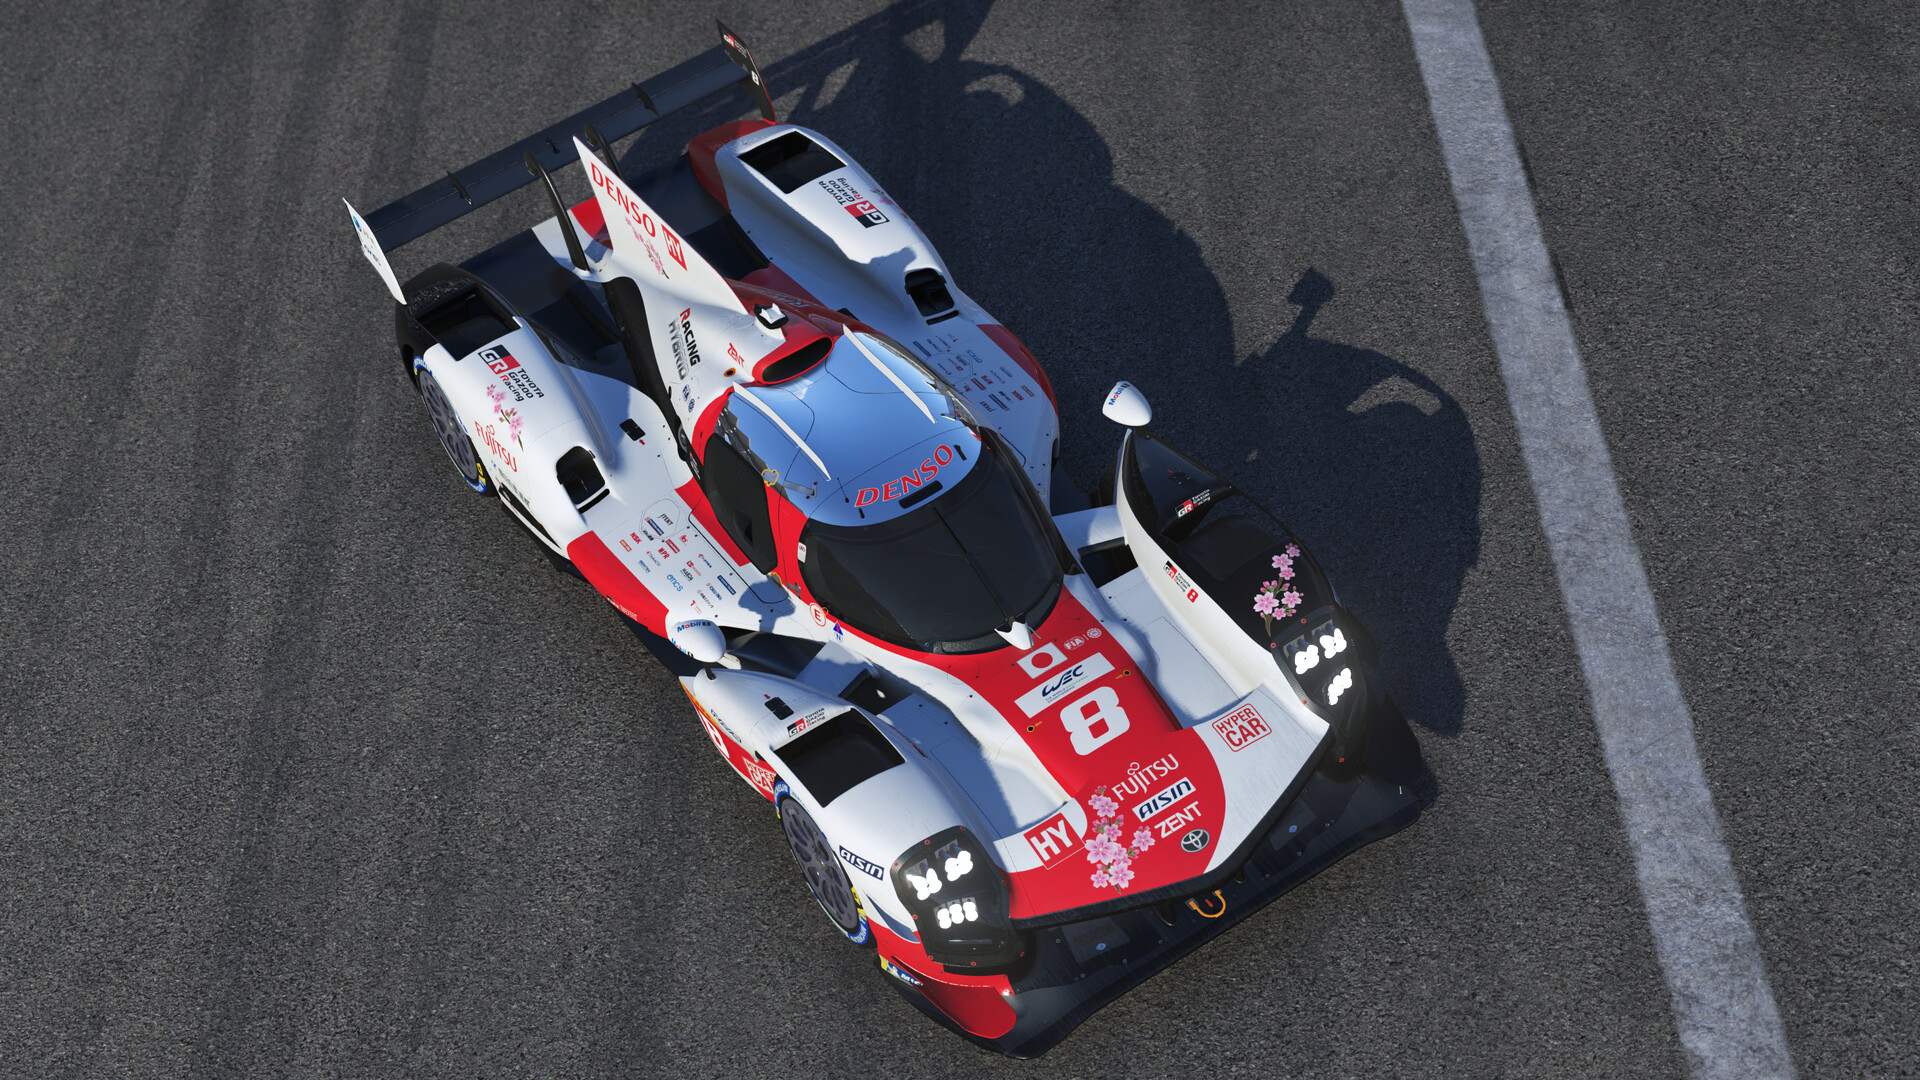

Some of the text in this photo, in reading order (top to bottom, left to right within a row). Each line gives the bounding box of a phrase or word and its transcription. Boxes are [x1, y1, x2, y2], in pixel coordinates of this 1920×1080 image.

[590, 162, 656, 238] DENSO
[818, 180, 847, 206] TOYOTA
[828, 179, 856, 203] GAZOO
[837, 177, 864, 200] Racing
[855, 201, 889, 225] GR
[668, 317, 690, 381] HYBRID
[680, 307, 701, 367] RACING
[479, 348, 510, 374] GR
[499, 374, 525, 402] Racing
[508, 371, 534, 399] GAZOO
[517, 368, 545, 398] TOYOTA
[474, 420, 518, 472] FUJITSU
[854, 444, 953, 508] DENSO
[630, 532, 642, 545] NSK
[1187, 588, 1199, 604] 8
[677, 621, 701, 633] Mobil
[1064, 637, 1084, 650] FIA
[1042, 665, 1084, 697] WEC
[788, 722, 807, 737] GR
[1059, 686, 1131, 756] 8
[1215, 707, 1255, 735] HYPER
[1224, 717, 1268, 748] CAR
[751, 770, 775, 790] CA
[1111, 753, 1180, 802] FUJITSU
[1138, 780, 1192, 820] AISIN
[1154, 801, 1203, 839] ZENT
[1029, 819, 1074, 862] HY
[840, 848, 884, 878] AISIN
